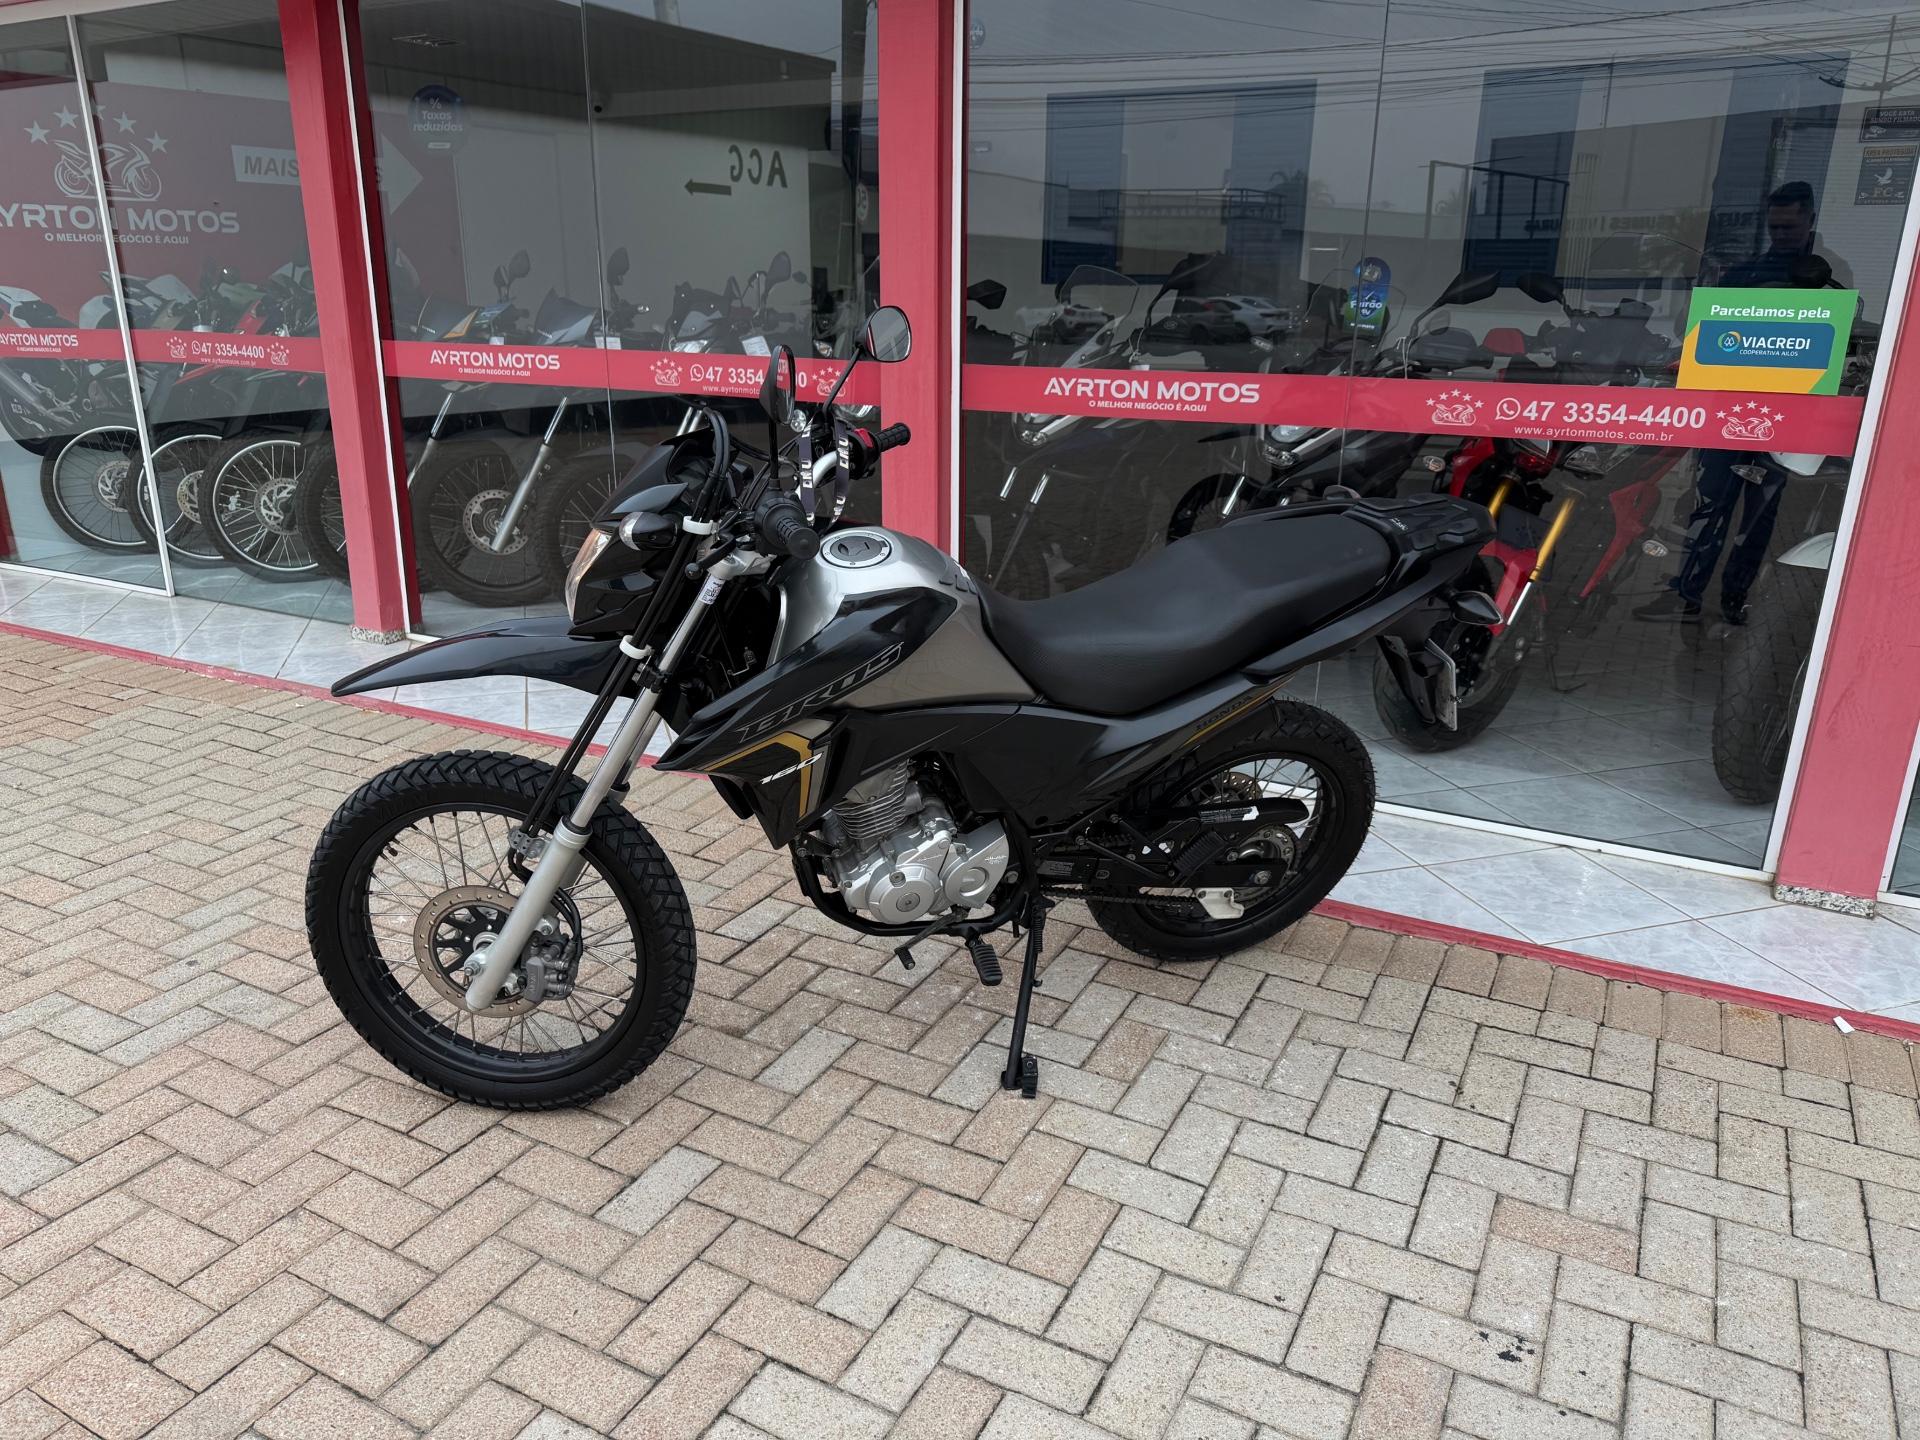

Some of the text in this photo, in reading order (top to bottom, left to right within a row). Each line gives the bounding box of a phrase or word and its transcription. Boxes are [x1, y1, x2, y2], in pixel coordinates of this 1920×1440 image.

[422, 110, 452, 120] Taxas
[413, 120, 463, 132] reduzidas
[244, 155, 299, 177] MAIS
[127, 207, 240, 233] MOTOS
[45, 232, 54, 241] O
[56, 232, 104, 242] MELHOR
[113, 233, 153, 244] EGÓCIO
[163, 235, 189, 245] AQUI
[1710, 304, 1831, 320] Parcelamos pela
[40, 334, 79, 347] MOTOS
[1742, 336, 1811, 350] VIACREDI
[201, 342, 265, 358] 47 3354-4400
[430, 350, 561, 370] AYRTON MOTOS
[705, 366, 723, 383] 47
[1043, 376, 1260, 403] AYRTON MOTOS
[1097, 400, 1133, 409] MELHOR
[1134, 401, 1175, 411] NEGÓCIO
[1176, 402, 1183, 411] É
[1183, 404, 1207, 412] AQUI
[1522, 400, 1707, 429] 47 3354-4400
[1514, 425, 1673, 442] www.ayrtonmotos.com.br
[760, 752, 823, 784] 160
